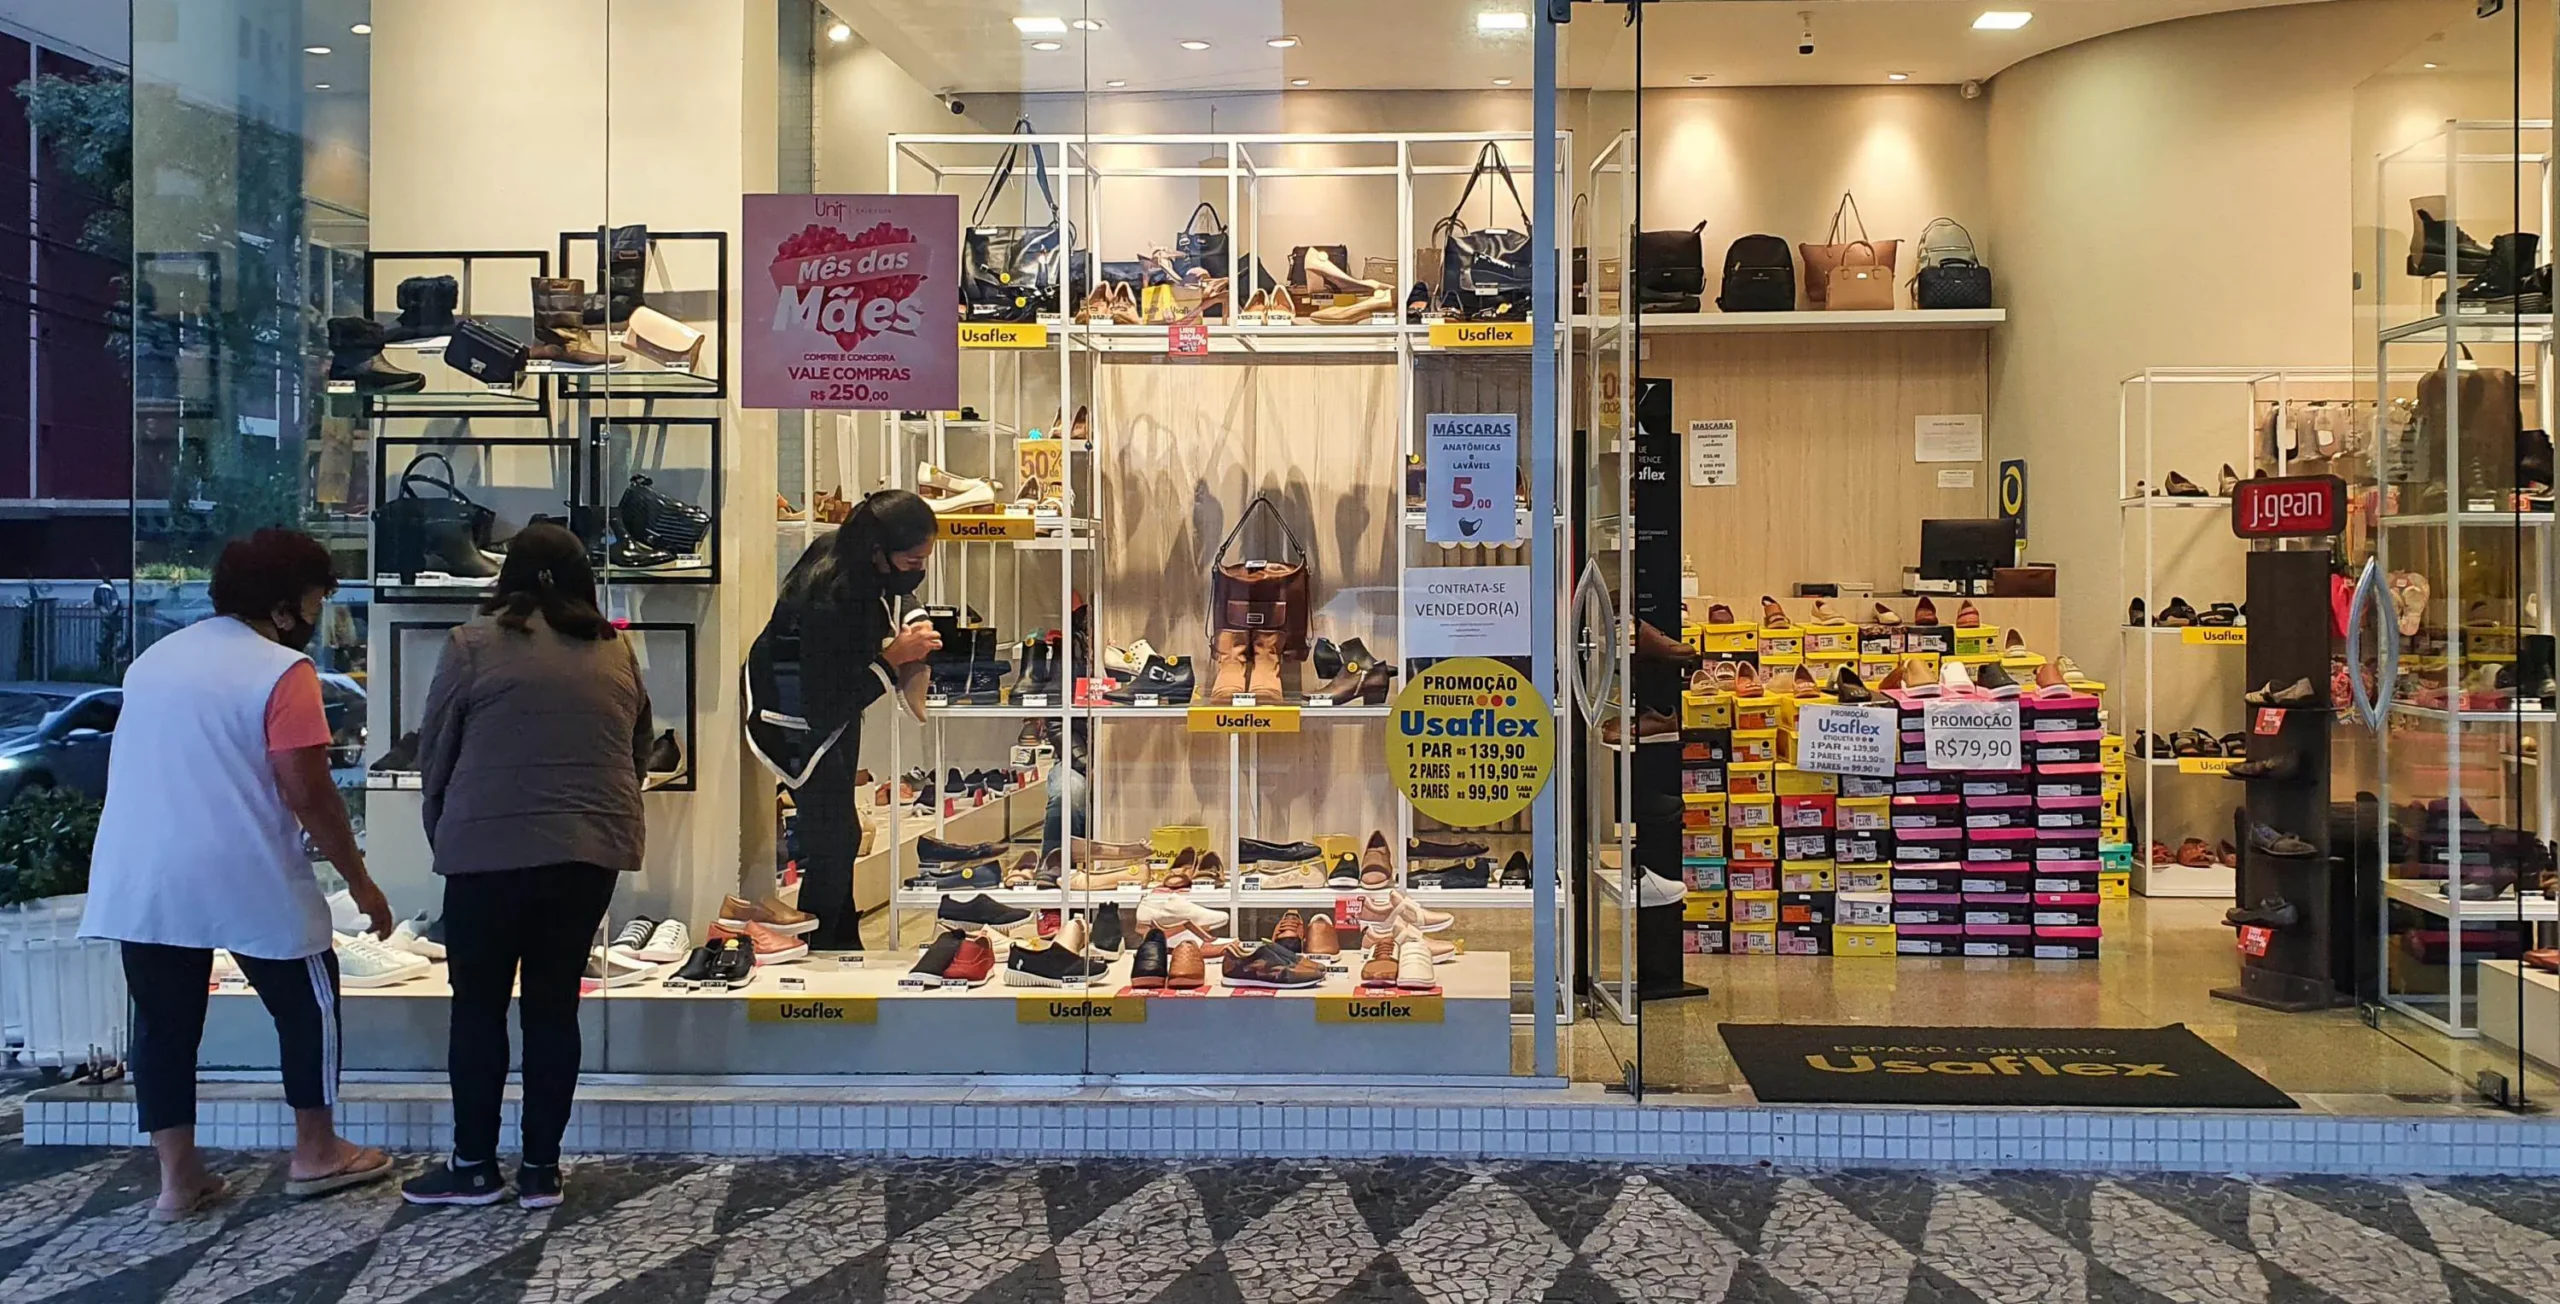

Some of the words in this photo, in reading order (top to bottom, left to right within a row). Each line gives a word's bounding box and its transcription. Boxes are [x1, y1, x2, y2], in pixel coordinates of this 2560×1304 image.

[797, 256, 851, 284] Mês
[857, 249, 909, 274] das
[772, 285, 925, 333] Mães
[962, 328, 1017, 344] Usaflex
[1457, 327, 1514, 342] Usaflex
[804, 353, 839, 361] COMPRE
[847, 354, 896, 362] CONCORRA
[788, 366, 830, 380] VALE
[833, 366, 911, 381] COMPRAS
[810, 390, 826, 402] R$
[829, 384, 889, 403] 250,00
[1432, 420, 1512, 437] MÁSCARAS
[1442, 442, 1501, 452] ANATÔMICAS
[1452, 461, 1491, 471] LAVÁVEIS
[1451, 476, 1492, 511] 5,00
[2250, 490, 2322, 528] j.gean
[950, 522, 1007, 537] Usaflex
[1427, 582, 1506, 595] CONTRATA-SE
[1415, 600, 1519, 618] VENDEDOR(A)
[2203, 631, 2245, 641] Usaflex
[1423, 673, 1518, 694] PROMOÇÃO
[1423, 694, 1475, 706] ETIQUETA
[1216, 714, 1271, 728] Usaflex
[1830, 709, 1869, 719] PROMOÇÃO
[1931, 712, 2013, 728] PROMOÇÃO
[1400, 708, 1540, 737] Usaflex
[1818, 718, 1880, 736] Usaflex
[1406, 743, 1414, 758] 1
[1421, 743, 1452, 758] PAR
[1456, 747, 1467, 757] R$
[1469, 743, 1525, 761] 139,90
[1811, 741, 1816, 749] 1
[1817, 742, 1842, 750] PAR
[1935, 738, 2012, 760] R$79,90
[1810, 751, 1816, 759] 2
[1817, 752, 1842, 760] PARES
[1409, 763, 1417, 779] 2
[1420, 763, 1450, 779] PARES
[1457, 771, 1466, 779] R$
[1469, 763, 1519, 782] 119,90
[1810, 761, 1815, 769] 3
[1816, 762, 1842, 771] PARES
[1410, 784, 1418, 799] 3
[1420, 783, 1449, 799] PARES
[1457, 791, 1465, 799] R$
[1468, 784, 1509, 803] 99,90
[780, 1003, 844, 1019] Usaflex
[1049, 1000, 1113, 1017] Usaflex
[1348, 1001, 1411, 1018] Usaflex
[1805, 1054, 2180, 1077] Usaflex
